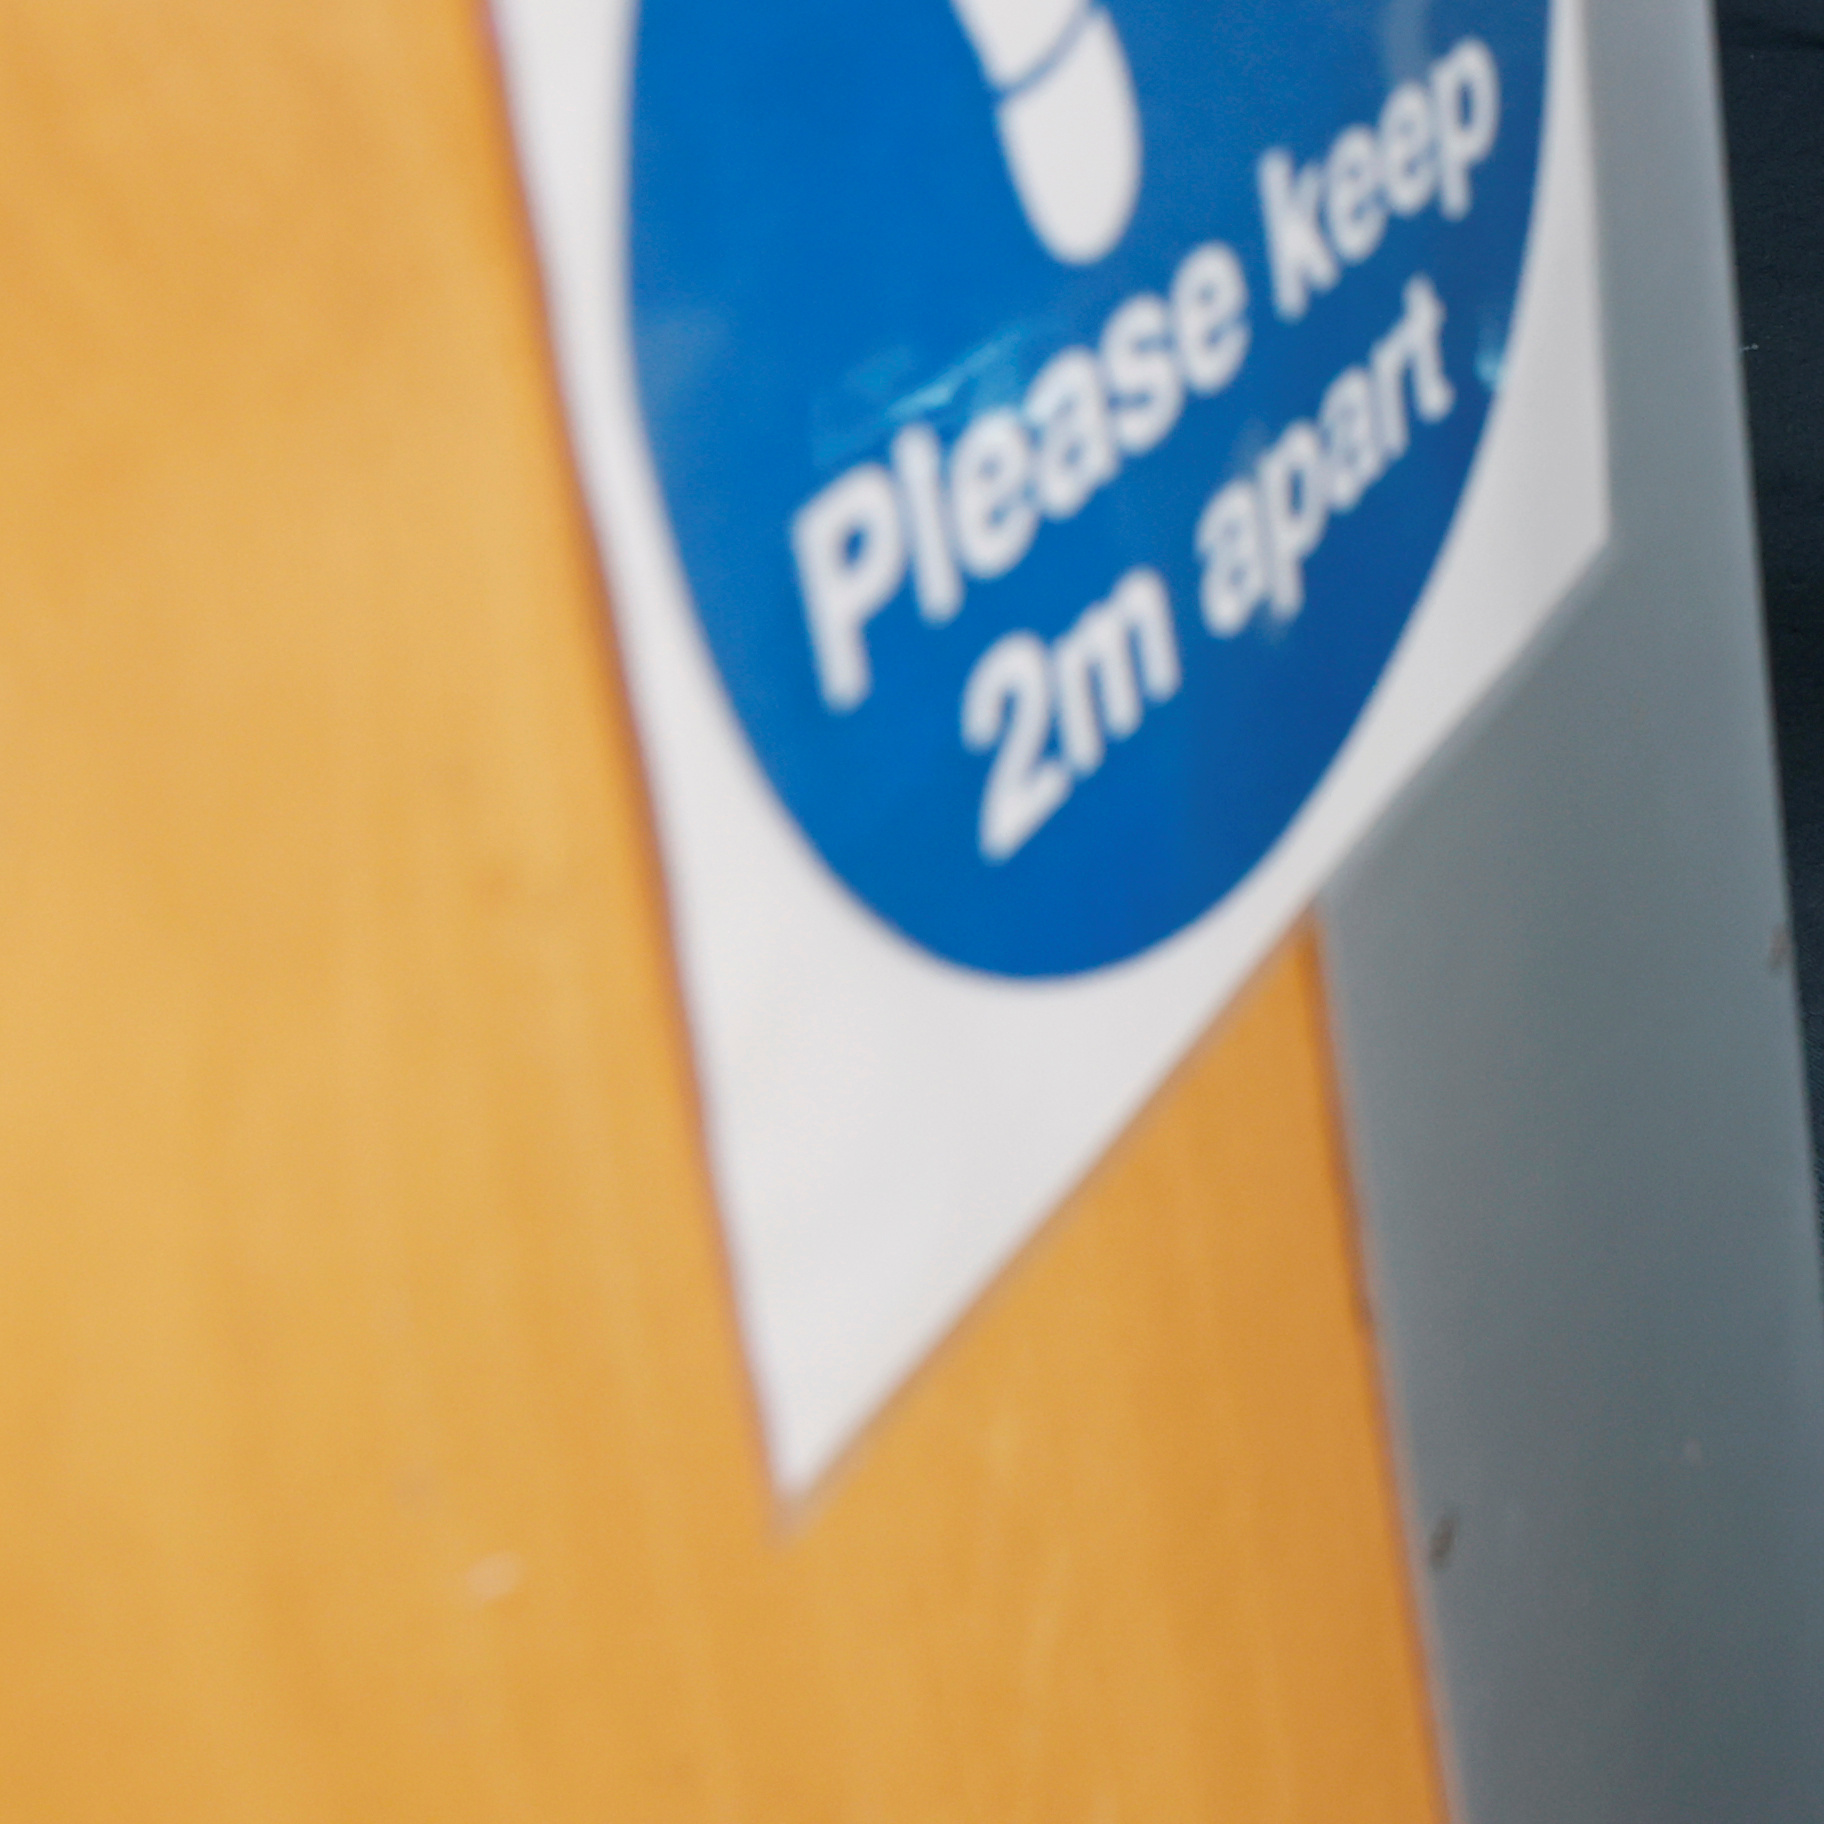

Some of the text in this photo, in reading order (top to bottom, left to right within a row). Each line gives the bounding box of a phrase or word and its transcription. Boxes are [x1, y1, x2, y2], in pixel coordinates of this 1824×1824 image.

[791, 35, 1500, 714] Please keep
[960, 273, 1456, 864] 2m apart
